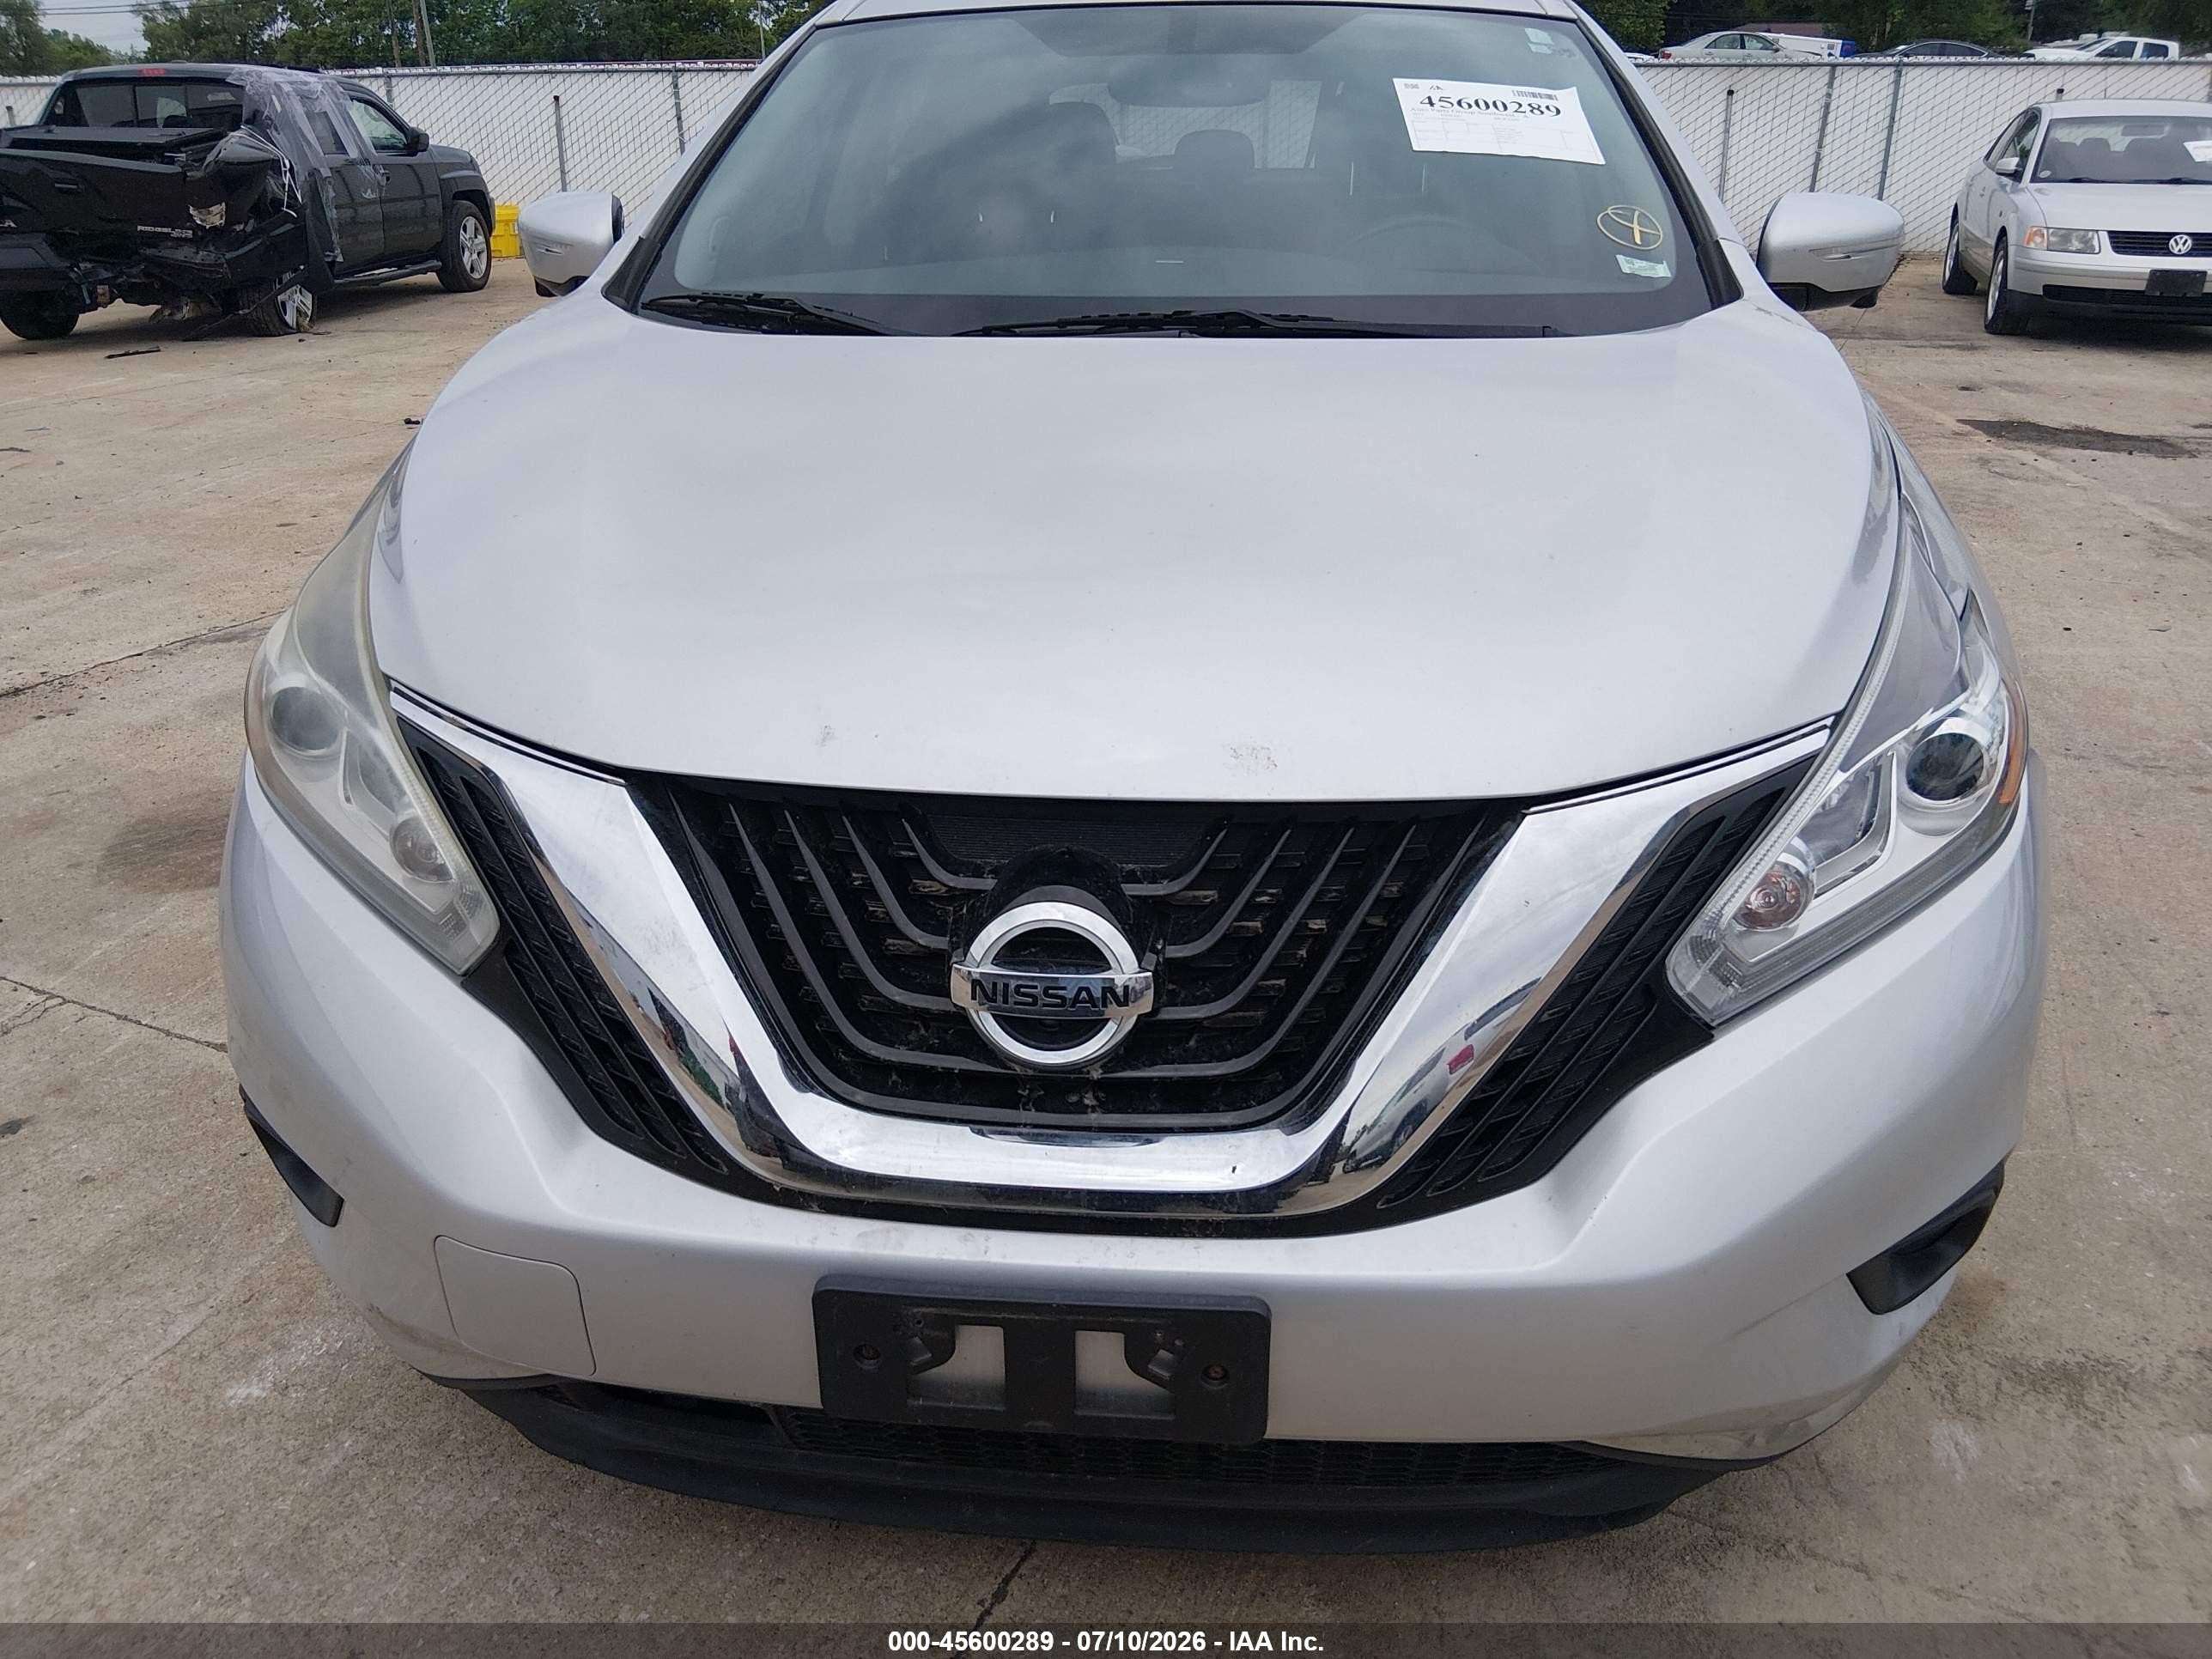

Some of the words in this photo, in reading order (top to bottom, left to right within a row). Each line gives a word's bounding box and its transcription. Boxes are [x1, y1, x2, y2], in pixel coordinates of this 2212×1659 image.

[1419, 95, 1562, 118] 45600289
[2168, 234, 2192, 255] VW
[970, 979, 1130, 1010] NISSAN
